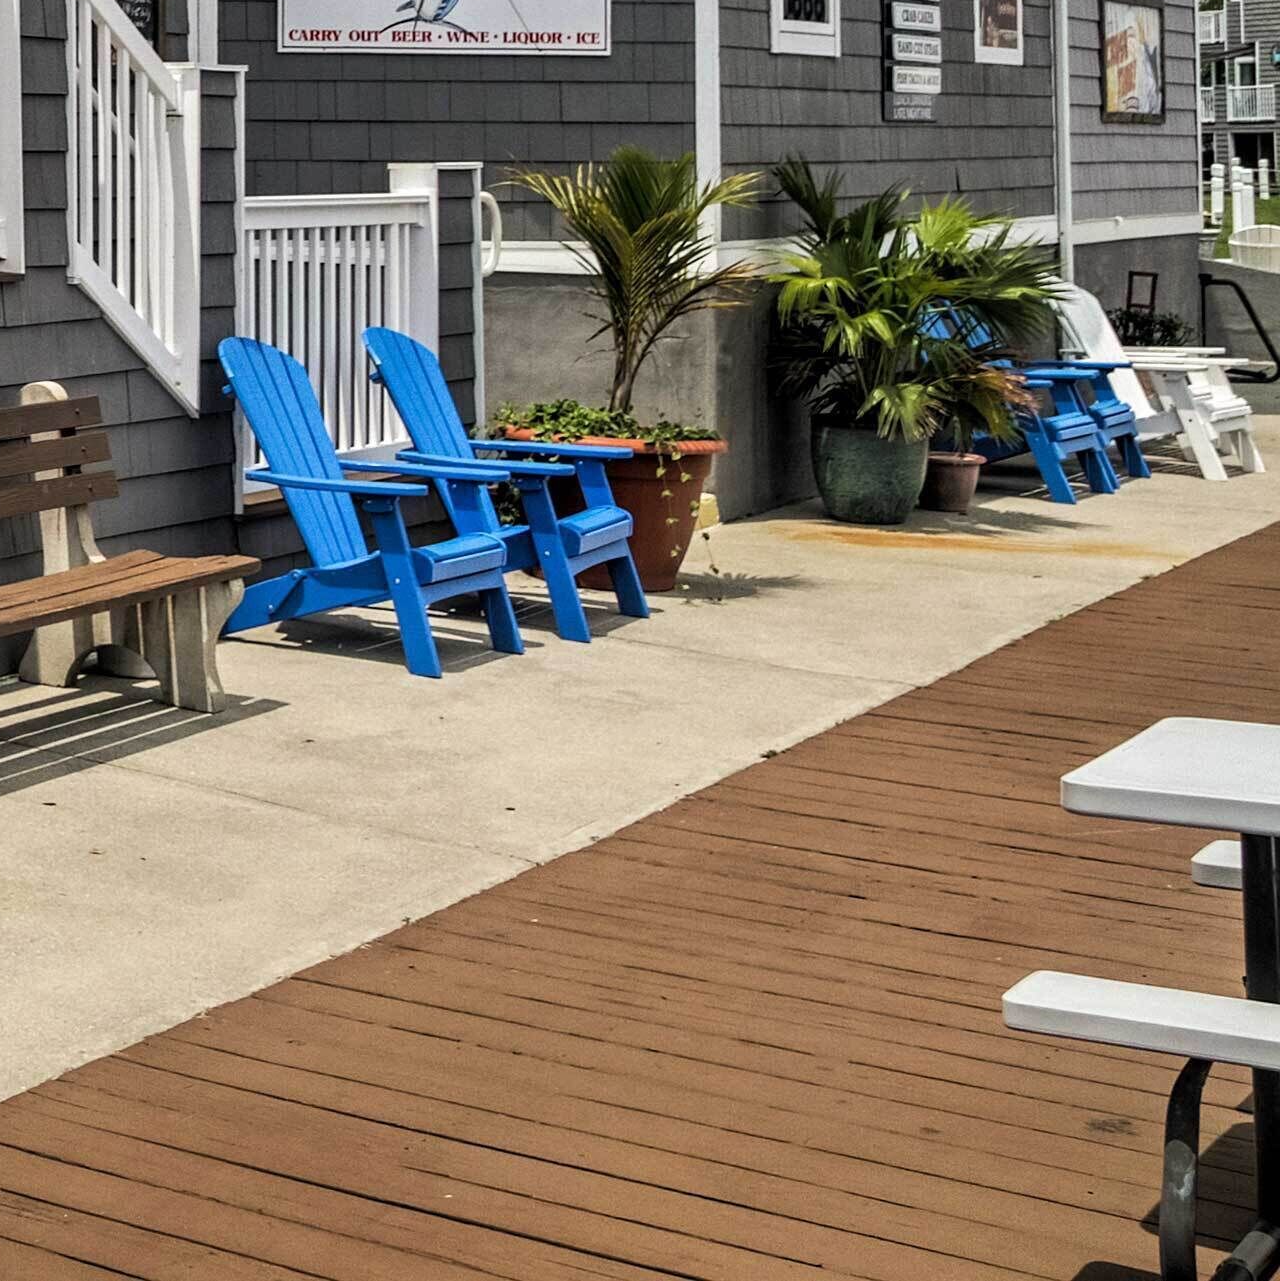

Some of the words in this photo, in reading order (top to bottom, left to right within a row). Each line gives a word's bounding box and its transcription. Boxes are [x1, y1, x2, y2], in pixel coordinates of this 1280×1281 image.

[288, 28, 343, 42] CARRY
[348, 30, 382, 43] OUT
[391, 30, 433, 43] BEER
[446, 31, 490, 44] WINE
[502, 31, 563, 45] LIQUOR
[575, 31, 600, 45] ICE
